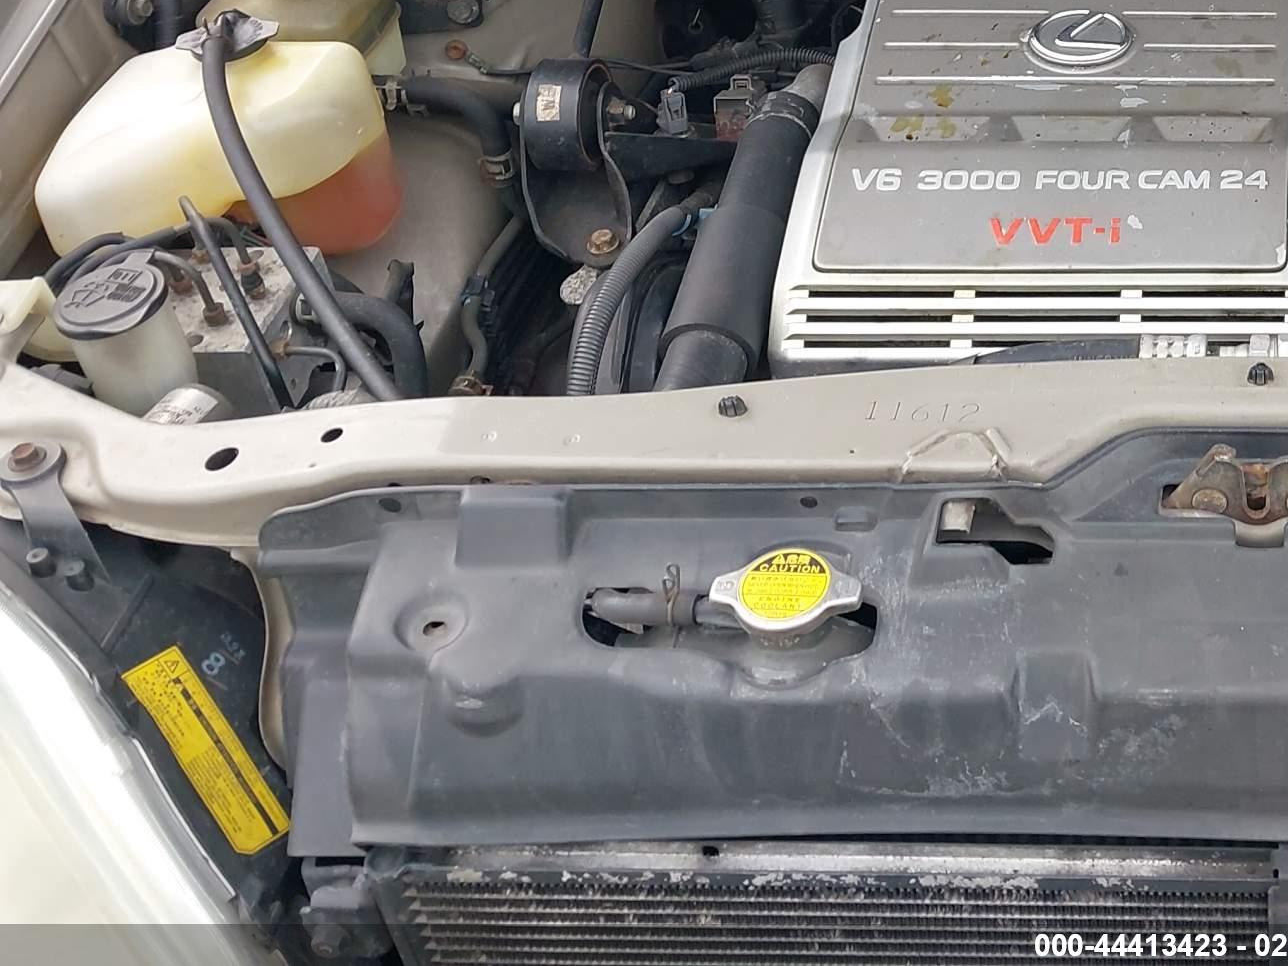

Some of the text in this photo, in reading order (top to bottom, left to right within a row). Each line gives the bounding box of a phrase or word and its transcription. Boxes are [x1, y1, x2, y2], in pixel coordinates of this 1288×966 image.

[851, 167, 1269, 191] V6 3000 FOUR CAM 24
[988, 217, 1122, 246] VVT-i
[864, 401, 981, 423] 11612
[759, 563, 820, 574] CAUTION
